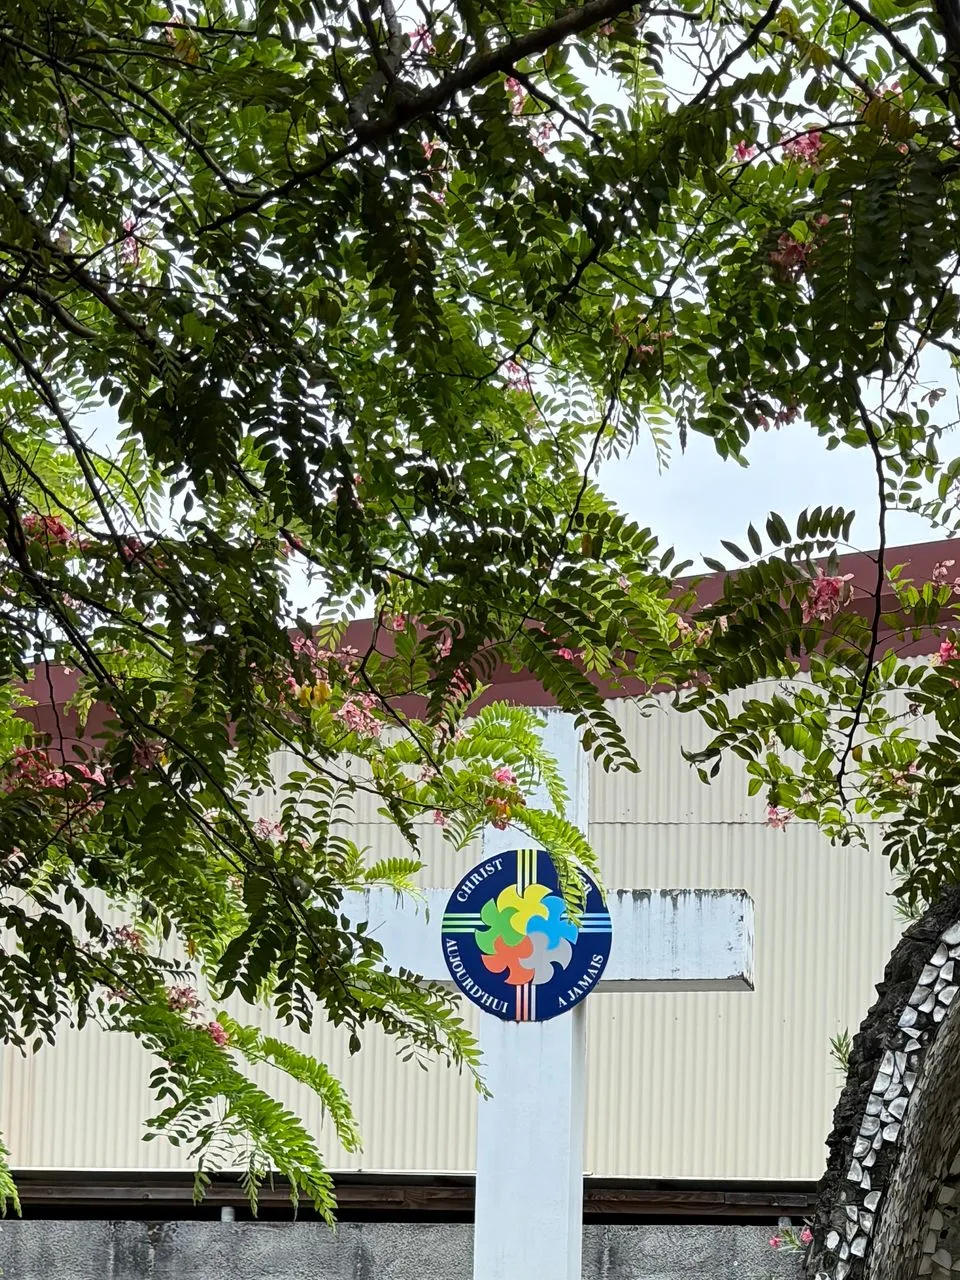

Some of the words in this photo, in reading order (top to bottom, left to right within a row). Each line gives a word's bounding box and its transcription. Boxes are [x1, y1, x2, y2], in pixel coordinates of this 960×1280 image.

[457, 858, 503, 902] CHRIST
[446, 938, 509, 1013] AUJOURD'HUI
[558, 996, 568, 1008] A
[567, 954, 604, 1001] JAMAIS
